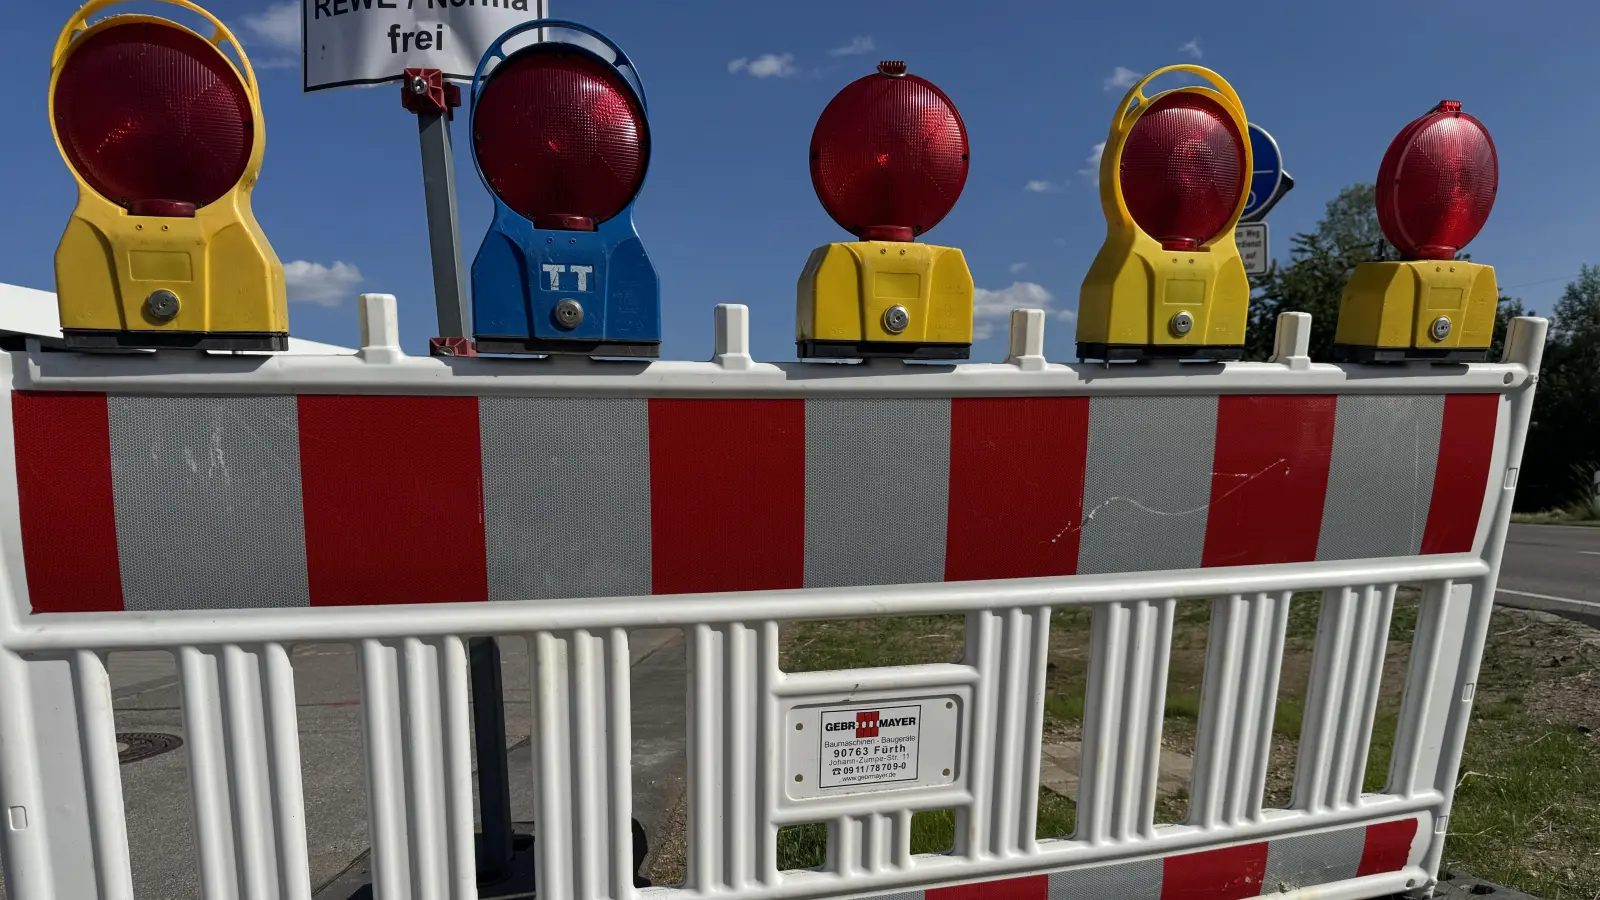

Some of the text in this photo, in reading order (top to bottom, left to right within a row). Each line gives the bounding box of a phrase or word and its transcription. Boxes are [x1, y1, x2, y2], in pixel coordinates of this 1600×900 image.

[387, 24, 443, 54] frei
[825, 717, 916, 732] GEBR MAYER
[824, 738, 876, 749] Baumaschinen
[881, 735, 916, 744] Baugeräte
[833, 744, 906, 758] 90763 Fürth
[828, 754, 899, 766] Johann-Zumpe-Str.
